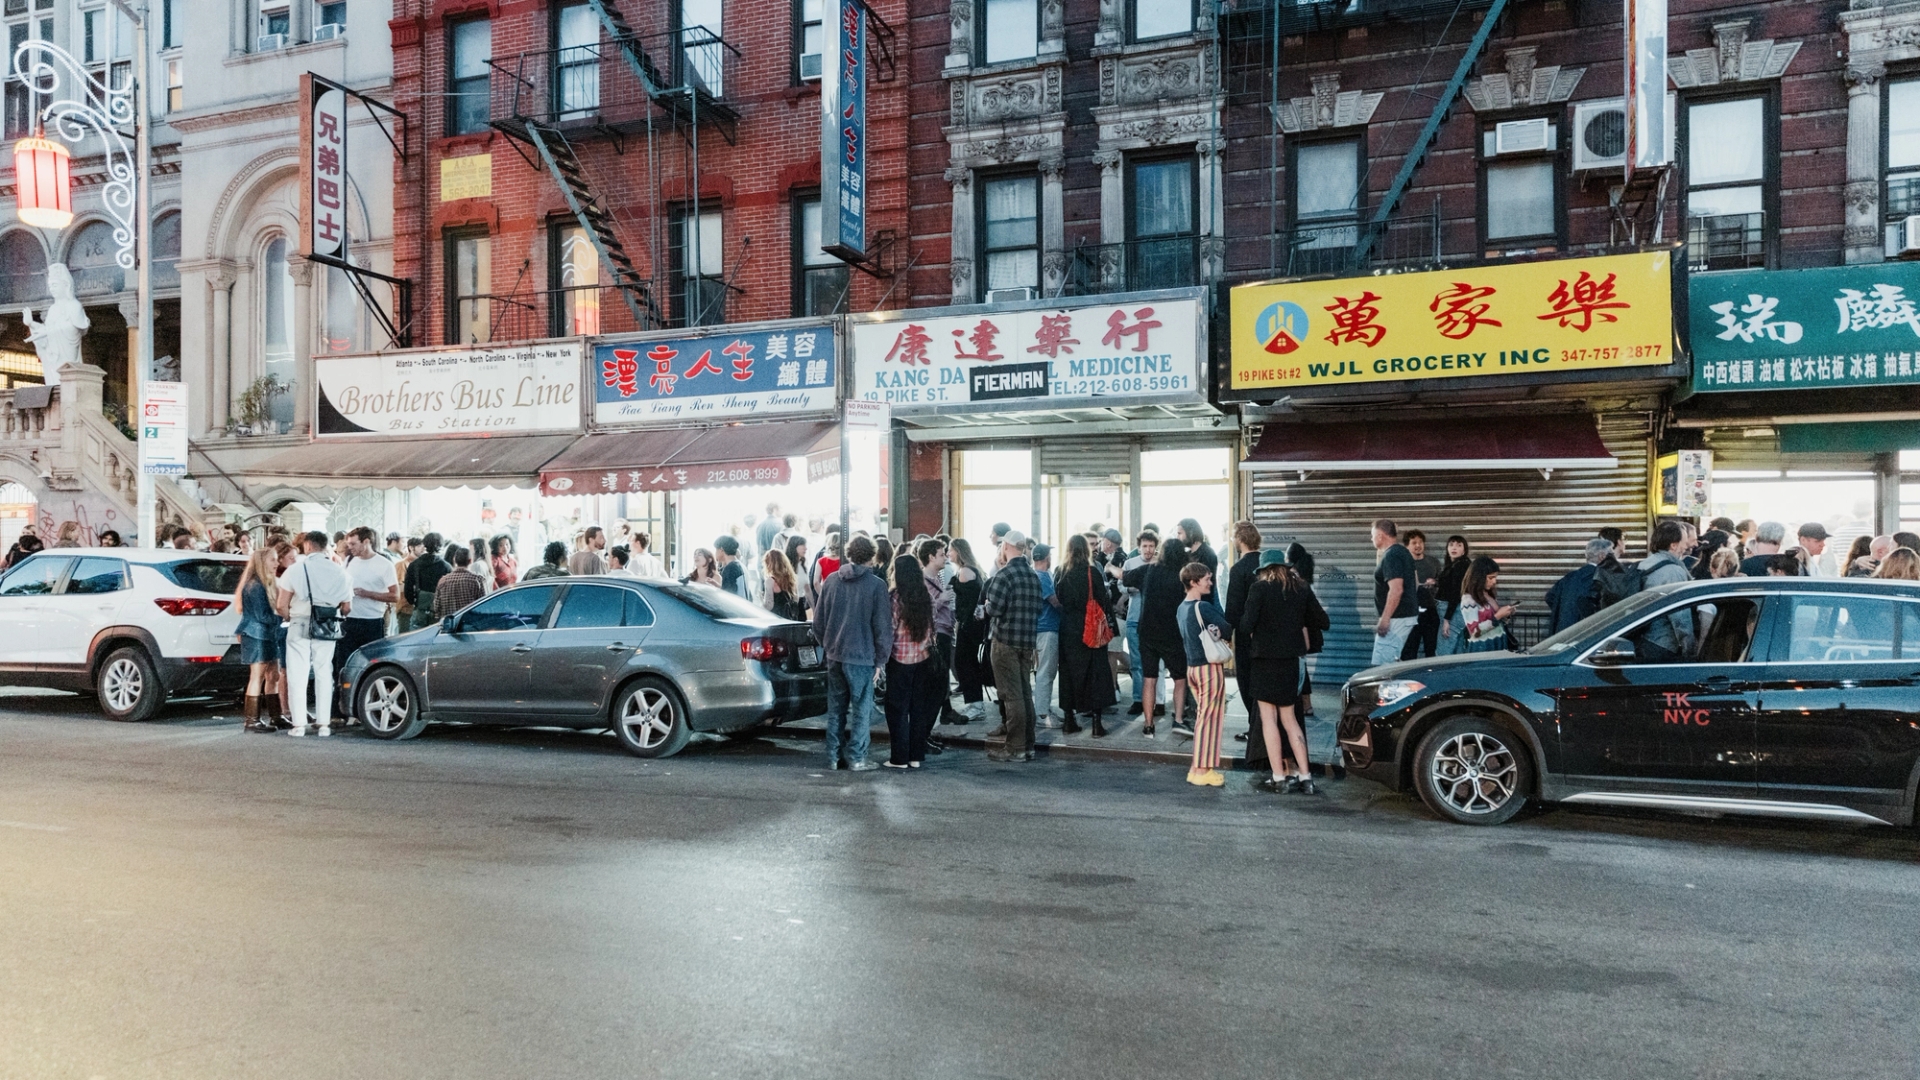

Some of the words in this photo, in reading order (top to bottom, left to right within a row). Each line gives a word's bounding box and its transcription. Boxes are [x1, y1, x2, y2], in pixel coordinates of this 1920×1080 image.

[317, 111, 341, 243] 兄弟巴士
[1322, 271, 1631, 349] 萬家樂
[765, 332, 817, 360] 美容
[884, 307, 1163, 366] 康達藥行
[396, 359, 413, 368] Atlanta
[422, 358, 436, 367] South
[438, 357, 458, 366] Carolina
[469, 356, 484, 364] North
[485, 354, 506, 362] Carolina
[516, 352, 536, 361] Virginia
[545, 350, 557, 358] New
[560, 349, 571, 357] York
[1308, 361, 1363, 378] WJL
[1373, 352, 1487, 374] GROCERY
[1500, 348, 1550, 366] INC
[1561, 344, 1662, 362] 347-757-2877
[602, 339, 755, 398] 漂亮人生
[875, 369, 930, 388] KANG
[939, 366, 965, 385] DA
[1069, 354, 1172, 378] MEDICINE
[1239, 370, 1249, 382] 19
[1252, 369, 1274, 381] PIKE
[1277, 368, 1287, 379] St
[1289, 367, 1301, 379] #2
[1850, 353, 1877, 379] 冰箱
[974, 370, 1044, 393] FIERMAN
[339, 380, 444, 415] Brothers
[450, 379, 505, 411] Bus
[512, 375, 575, 408] Line
[650, 400, 682, 417] Liang
[689, 398, 714, 411] Ren
[722, 395, 758, 411] Sheng
[766, 392, 811, 408] Beauty
[885, 388, 919, 402] PIKE
[926, 387, 948, 401] ST.
[147, 428, 155, 438] 2
[389, 418, 425, 430] Bus
[437, 415, 517, 429] Station
[602, 468, 688, 491] 漂亮人生
[707, 467, 779, 483] 212.608.1899
[1662, 691, 1691, 707] TK
[1664, 709, 1710, 726] NYC
